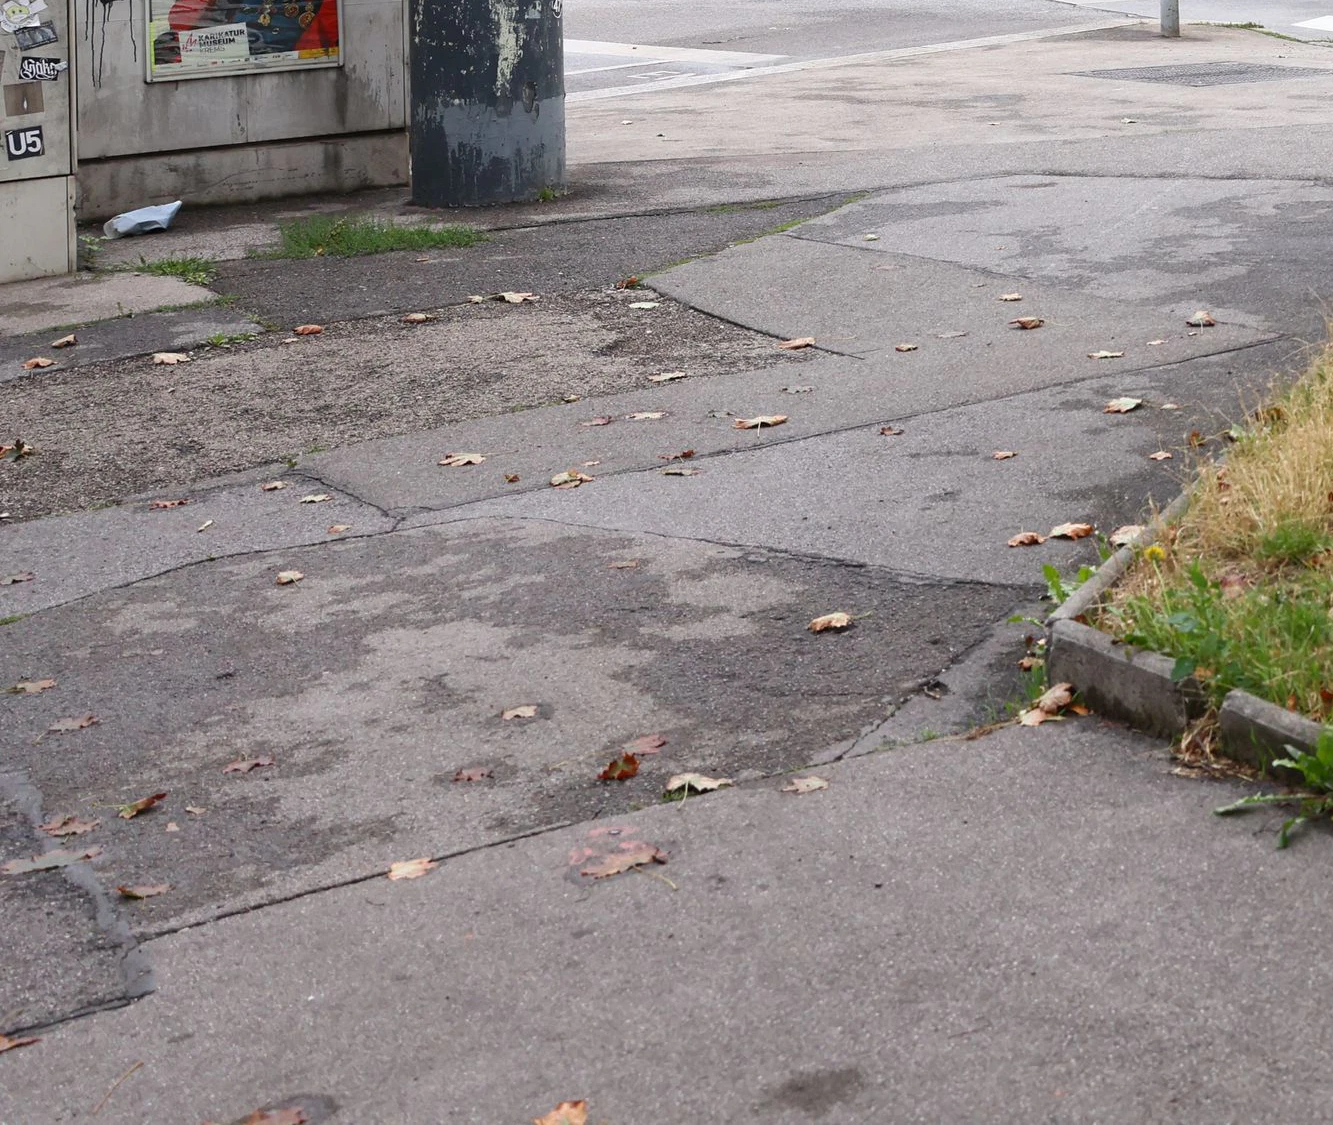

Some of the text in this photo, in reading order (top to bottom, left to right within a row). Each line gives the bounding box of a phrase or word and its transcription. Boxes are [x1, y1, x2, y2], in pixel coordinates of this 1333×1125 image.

[199, 29, 246, 42] KARIKATUR
[199, 38, 236, 48] MUSEUM
[8, 130, 41, 156] U5
